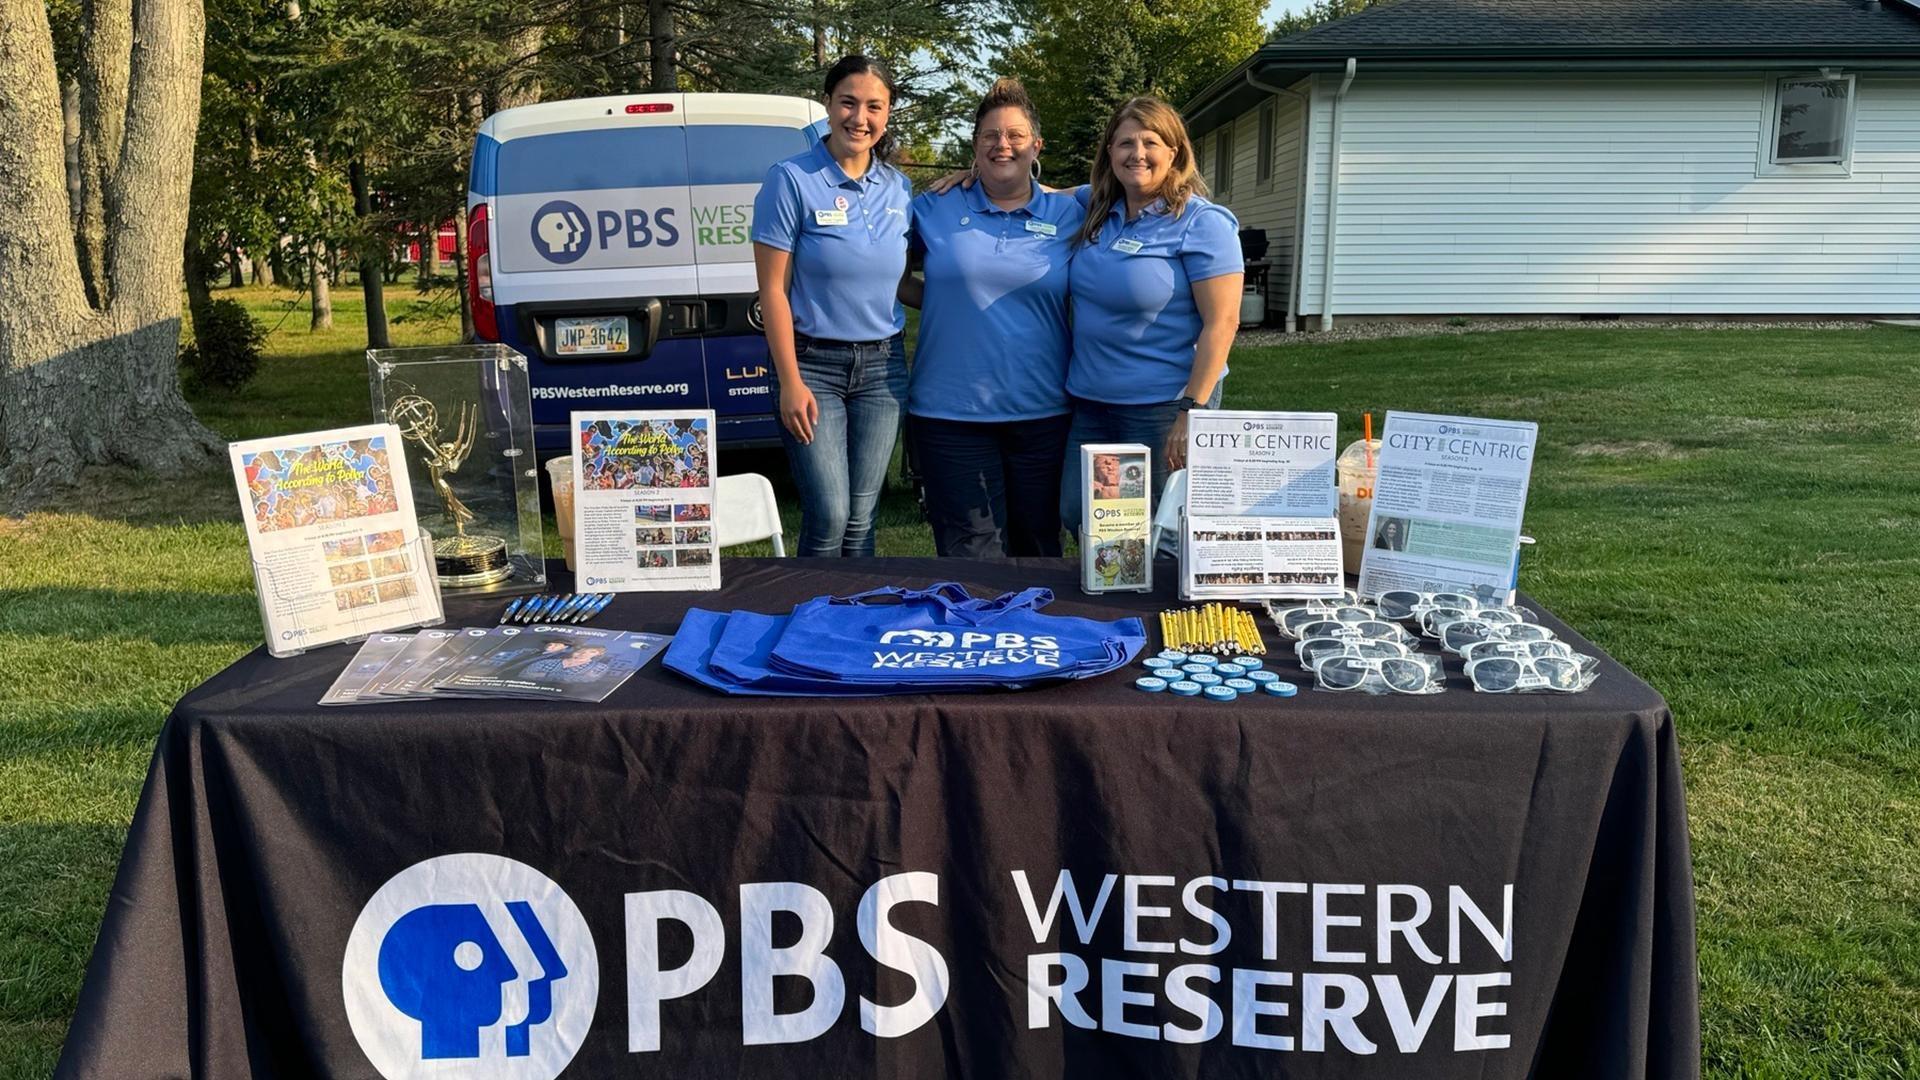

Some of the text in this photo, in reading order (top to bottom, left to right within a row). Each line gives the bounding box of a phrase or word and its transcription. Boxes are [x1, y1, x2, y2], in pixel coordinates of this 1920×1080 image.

[596, 207, 680, 250] PBS
[561, 327, 623, 347] JWP 3642
[531, 382, 689, 400] PBSWesternReserve.org
[623, 432, 667, 445] The World
[1195, 433, 1241, 448] CITY
[1254, 434, 1331, 450] CENTRIC
[1389, 433, 1436, 451] CITY
[1448, 438, 1530, 461] CENTRIC
[603, 443, 684, 457] According to Polka
[295, 459, 344, 476] The World
[275, 469, 365, 491] According to Polka
[1106, 509, 1121, 517] PBS
[960, 632, 1060, 650] PBS
[871, 655, 1061, 669] RESERVE
[872, 648, 1060, 664] WESTERN
[1010, 869, 1515, 965] WESTERN
[624, 871, 950, 1054] PBS
[1027, 953, 1512, 1055] RESERVE
